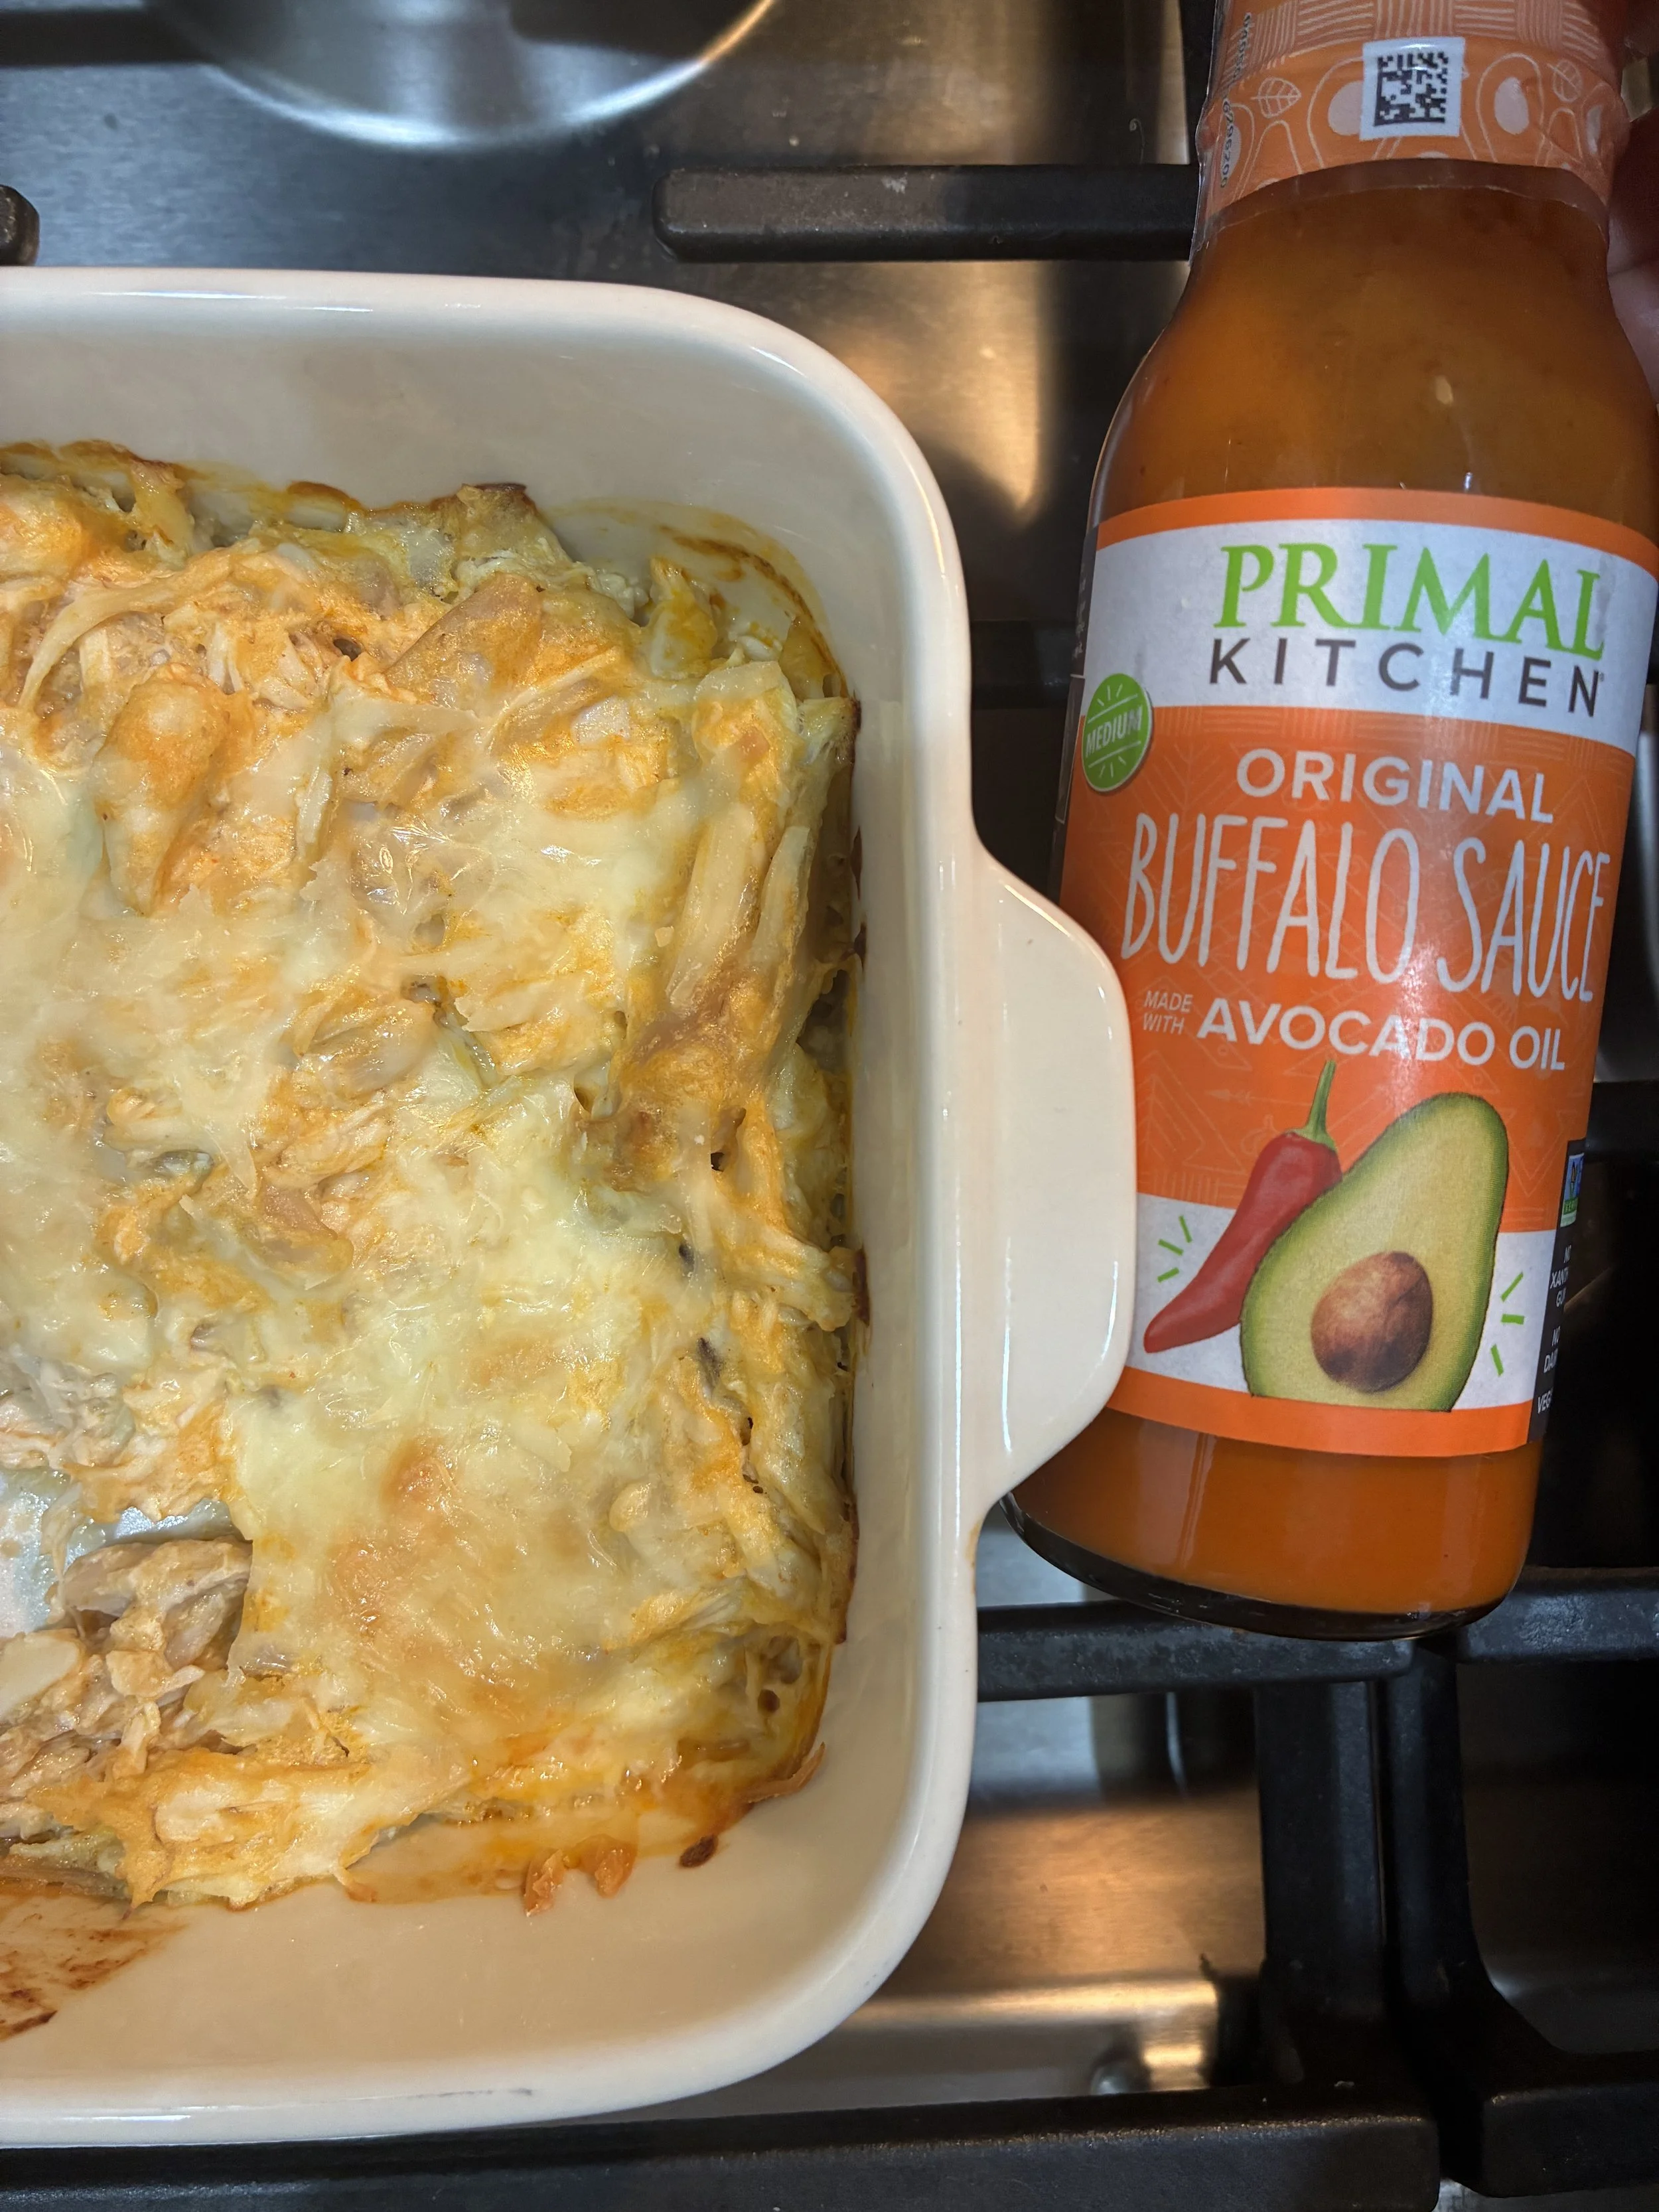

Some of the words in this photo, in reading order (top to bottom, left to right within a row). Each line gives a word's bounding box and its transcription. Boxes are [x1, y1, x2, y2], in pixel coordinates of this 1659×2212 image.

[1214, 543, 1605, 661] PRIMAL
[1209, 638, 1599, 717] KITCHEN
[1085, 705, 1143, 758] MEDIUM
[1237, 749, 1553, 824] ORIGINAL
[1121, 812, 1419, 985] BUFFALO
[1437, 837, 1611, 1002] SAUCE
[1143, 990, 1194, 1013] MADE
[1143, 1012, 1185, 1035] WITH
[1196, 997, 1496, 1067] AVOCADO
[1508, 1024, 1566, 1070] OIL
[1556, 1286, 1566, 1307] GU
[1538, 1387, 1553, 1414] VEG
